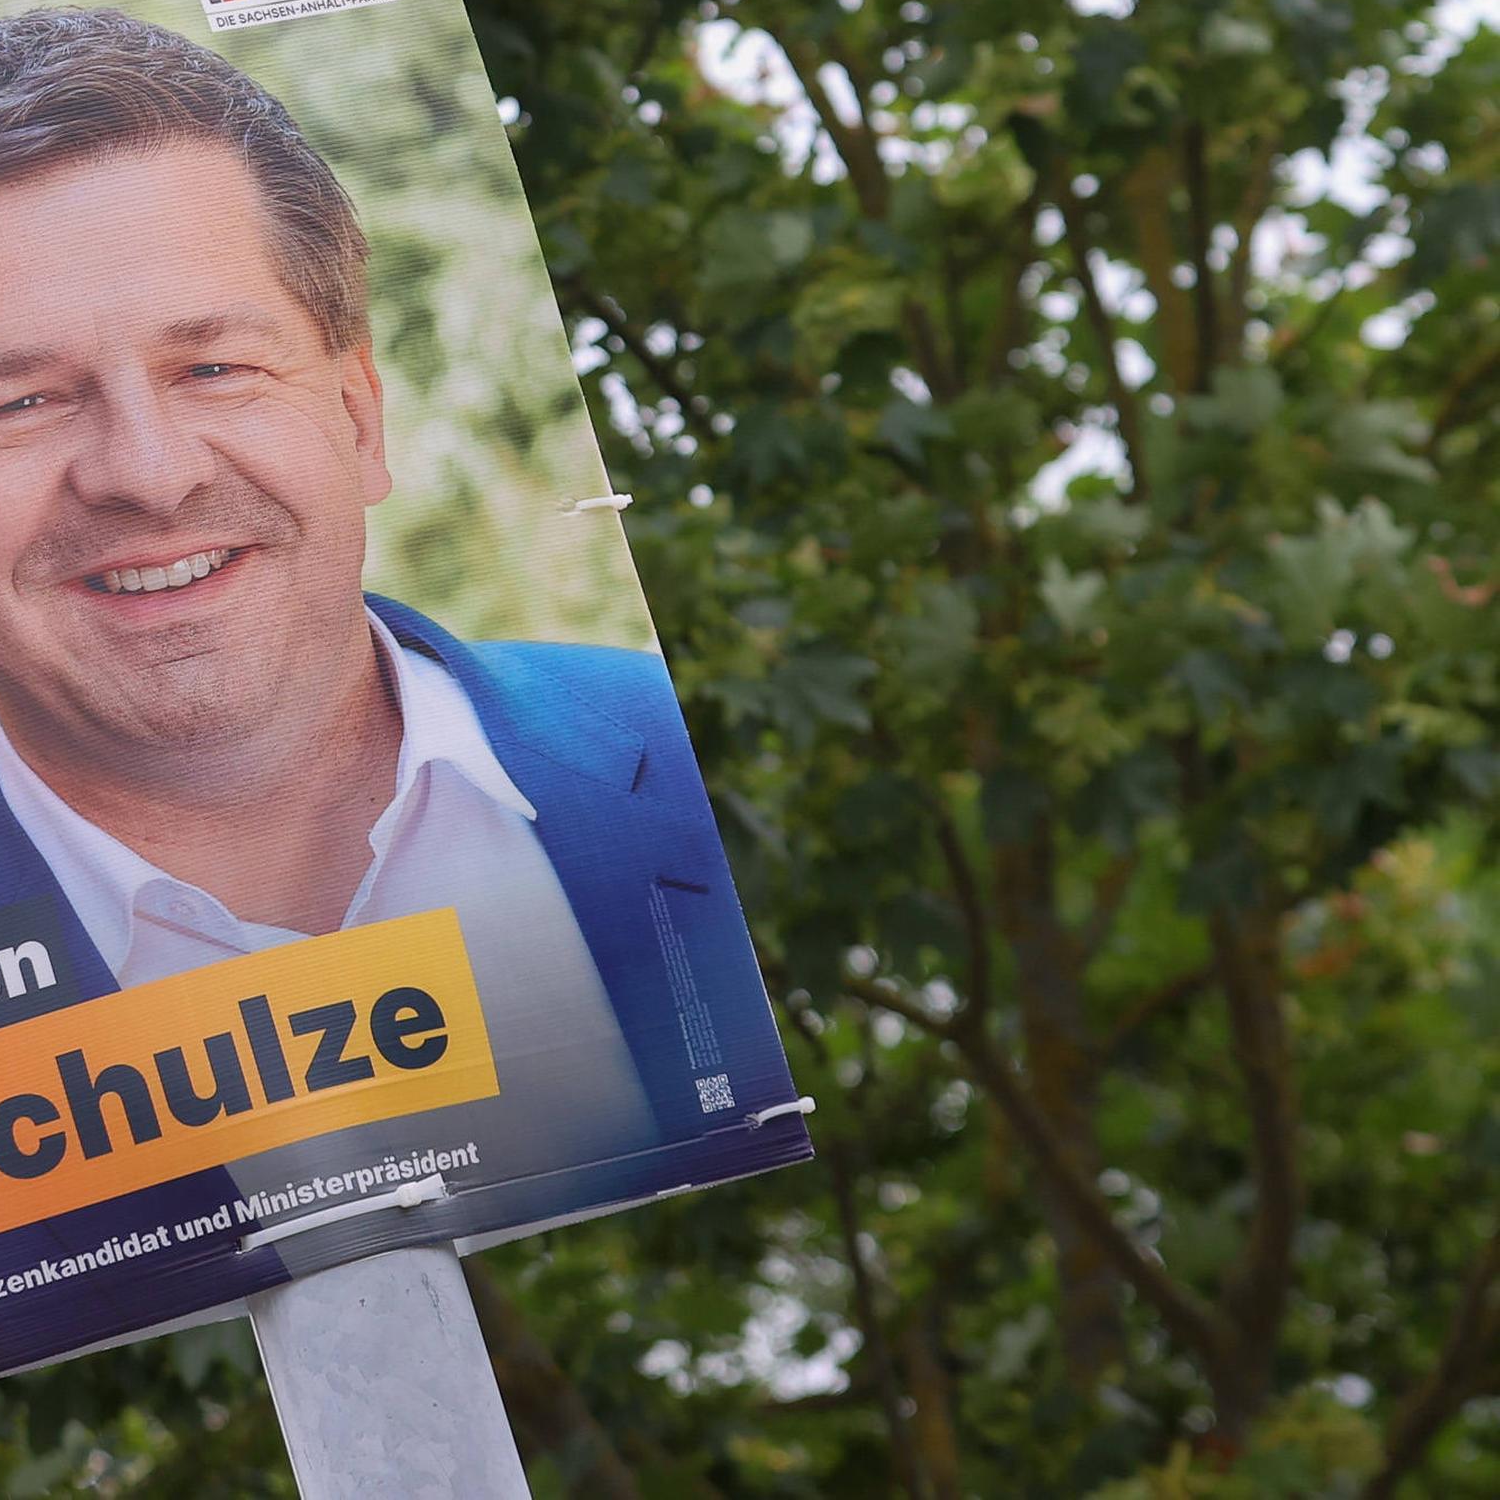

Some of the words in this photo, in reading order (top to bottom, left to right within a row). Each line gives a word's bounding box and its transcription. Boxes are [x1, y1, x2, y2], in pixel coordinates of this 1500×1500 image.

[216, 14, 236, 28] DIE
[174, 1204, 232, 1242] und
[236, 1141, 480, 1226] Ministerpräsident
